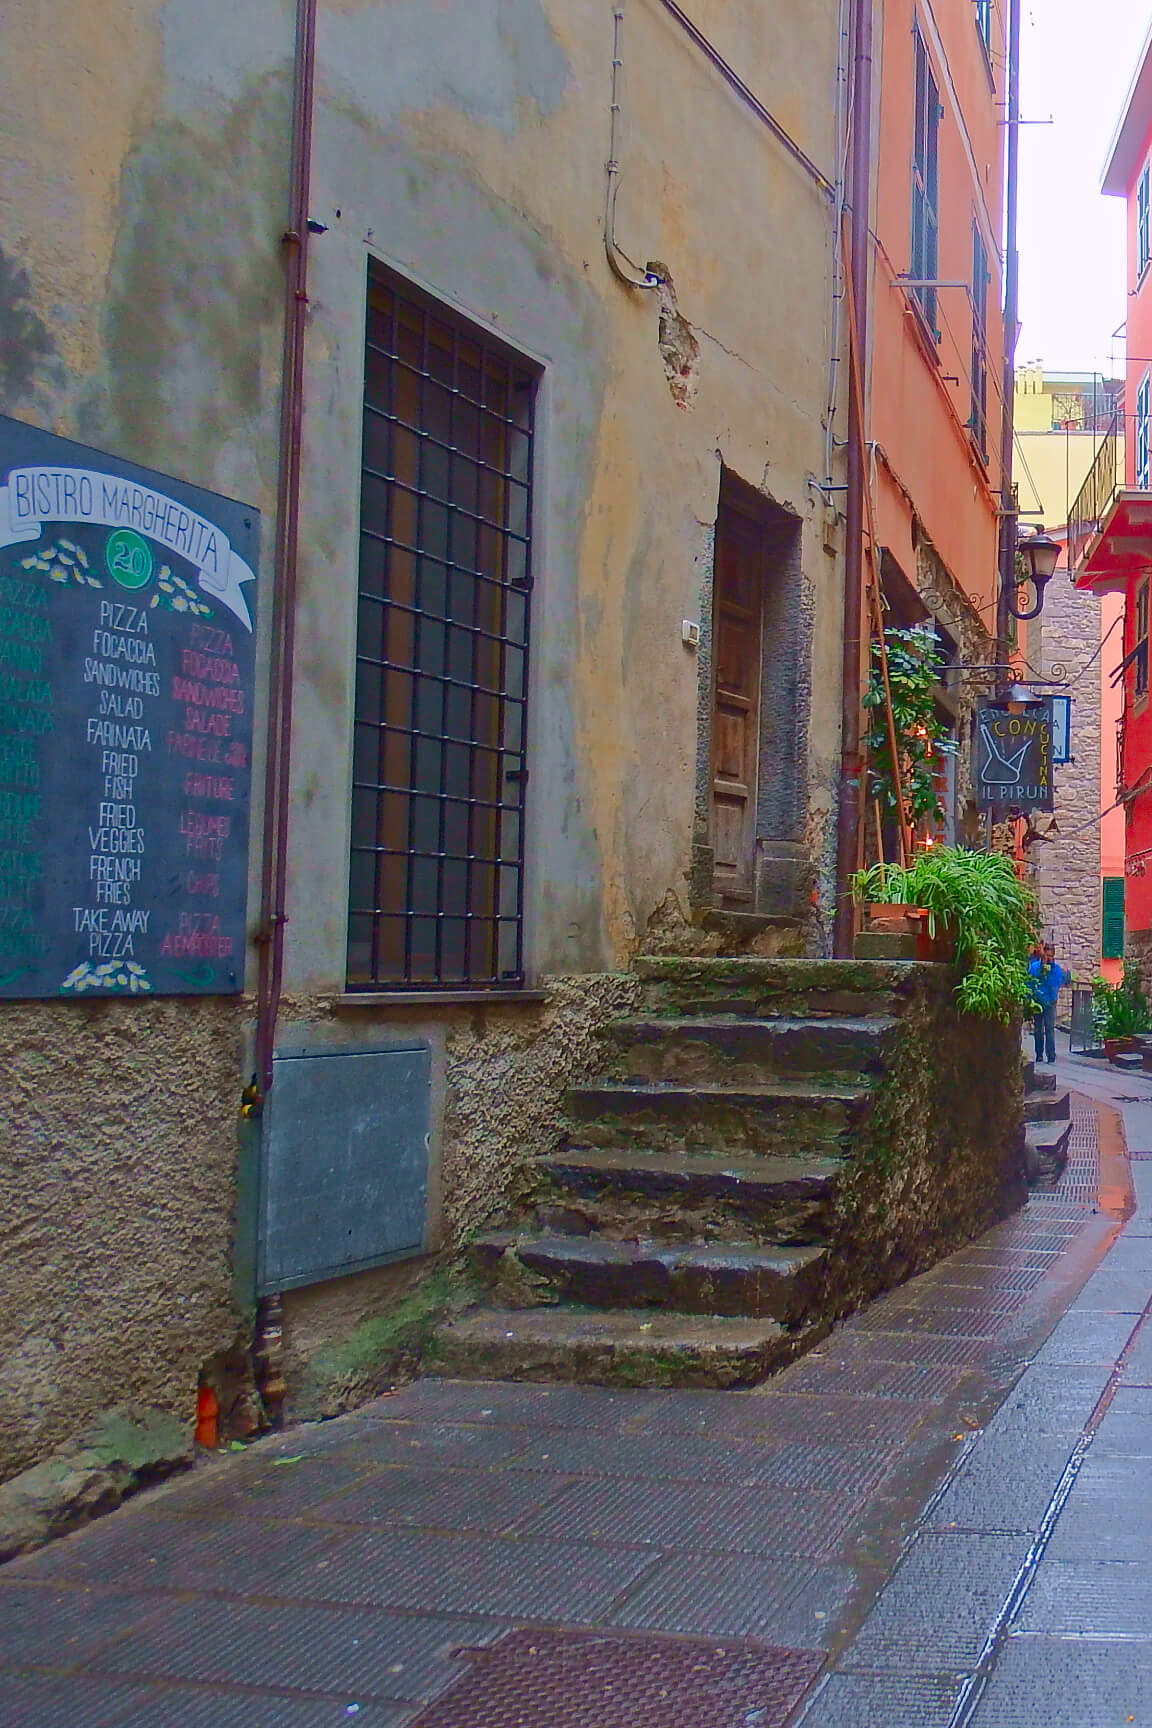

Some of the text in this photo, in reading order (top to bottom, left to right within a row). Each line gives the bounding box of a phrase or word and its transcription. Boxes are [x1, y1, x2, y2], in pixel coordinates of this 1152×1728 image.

[16, 474, 218, 573] BISTRO MARGHERITA
[113, 541, 148, 577] 20
[100, 601, 148, 634] PIZZA
[93, 630, 156, 666] FOCACCIA
[84, 658, 160, 697] SANDWICHES
[100, 690, 143, 720] SALAD
[87, 718, 152, 751] FARINATA
[994, 719, 1037, 737] CON
[102, 750, 138, 777] FRIED
[1039, 723, 1050, 785] CUCINA
[104, 776, 132, 800] FISH
[982, 785, 1048, 799] IL PIRUN
[100, 802, 135, 829] FRIED
[89, 826, 145, 854] VEGGIES
[90, 855, 140, 883] FRENCH
[96, 881, 131, 905] FRIES
[72, 907, 150, 934] TAKE AWAY
[89, 933, 134, 957] PIZZA
